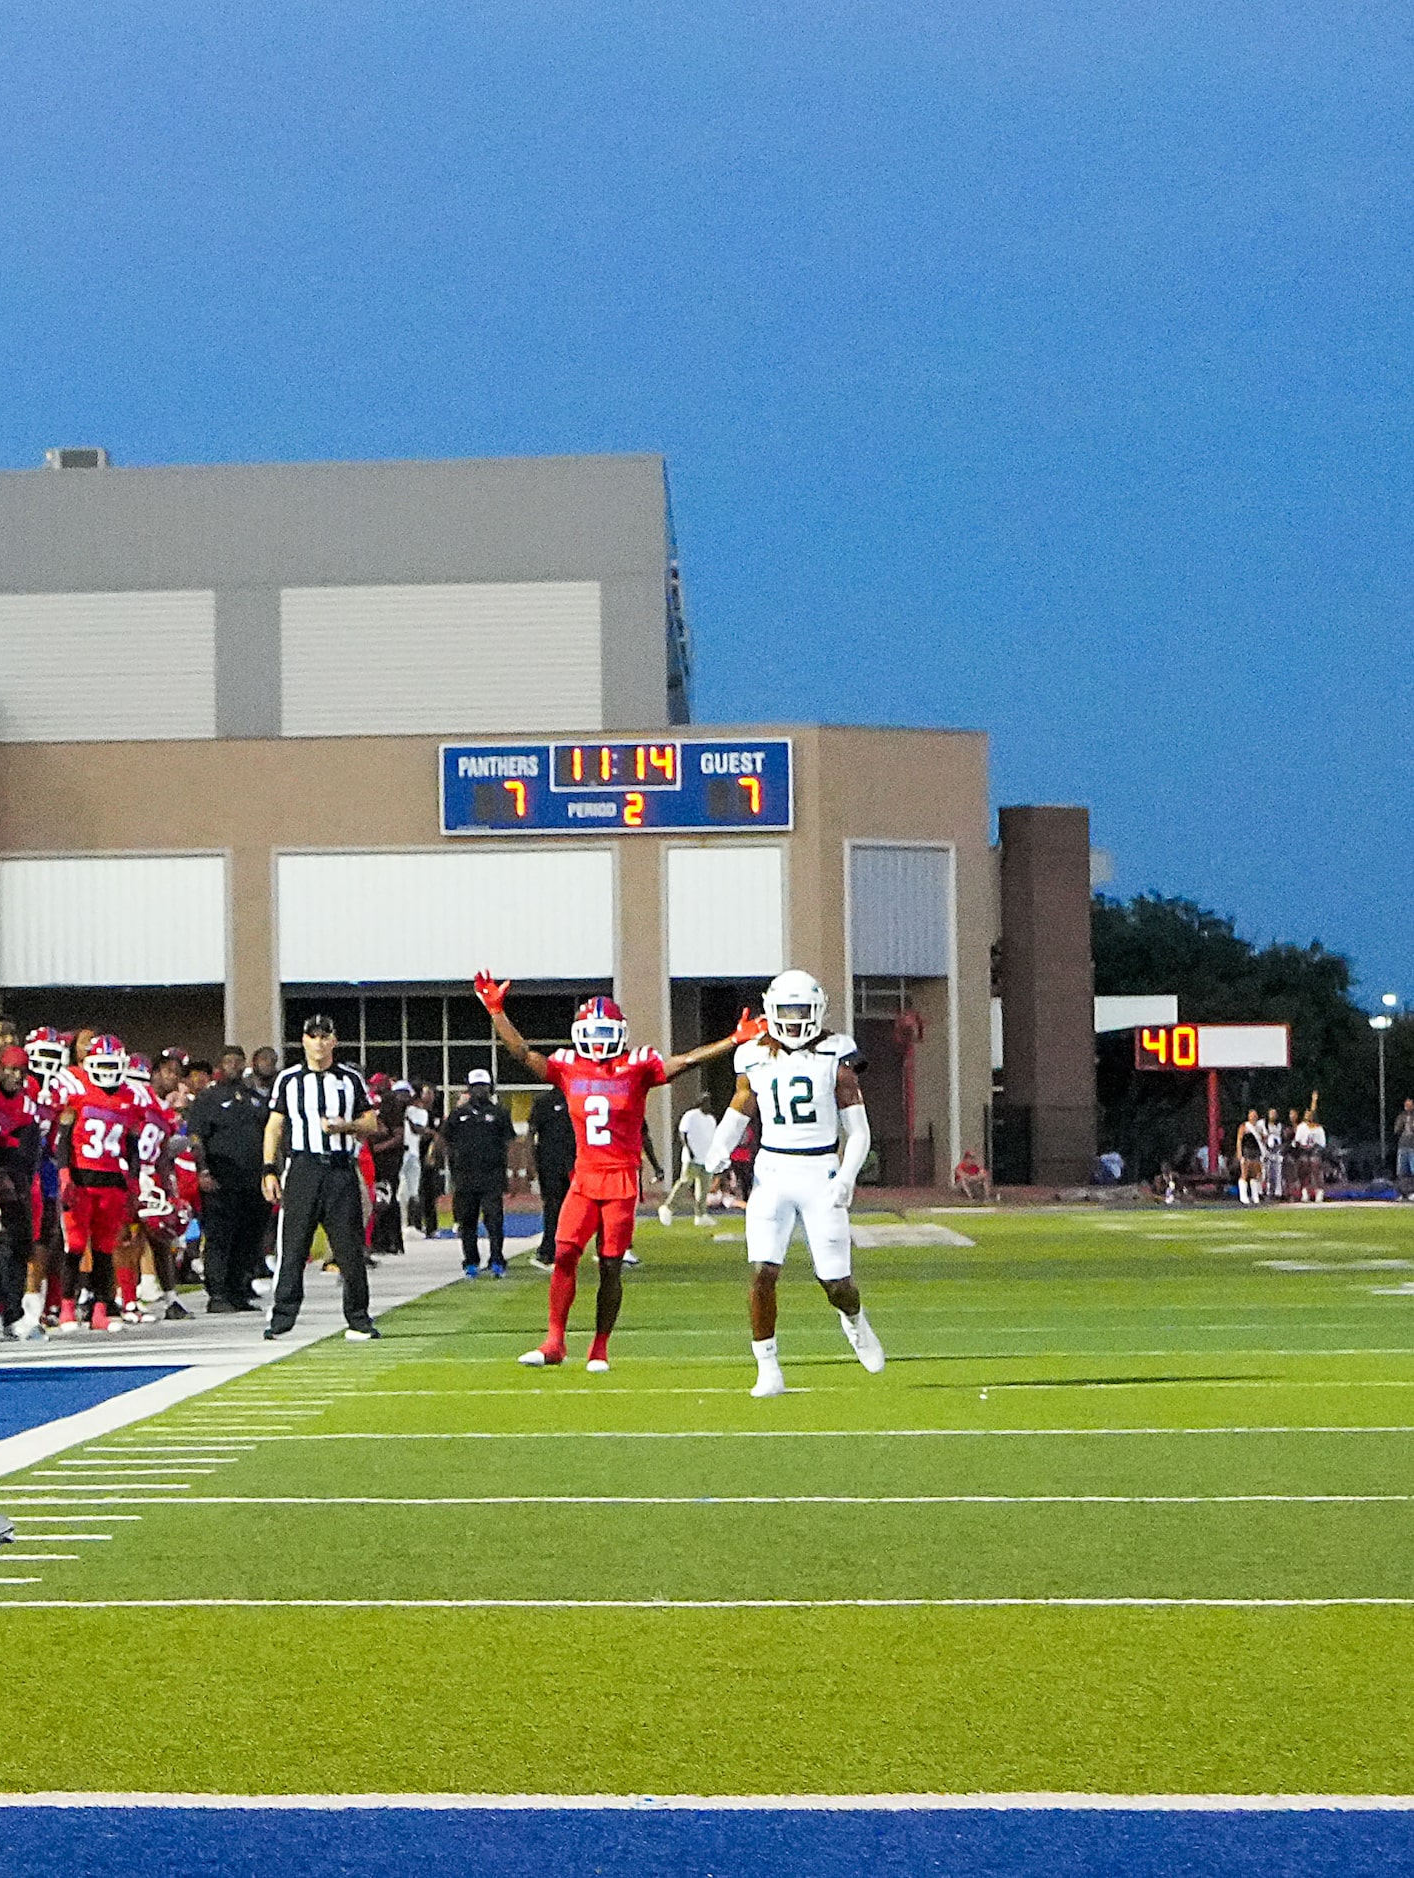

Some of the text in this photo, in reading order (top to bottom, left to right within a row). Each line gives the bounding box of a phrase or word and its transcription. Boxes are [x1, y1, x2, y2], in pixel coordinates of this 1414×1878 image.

[458, 755, 539, 778] PANTHERS
[572, 746, 674, 782] 11:14
[700, 751, 766, 775] GUEST
[502, 778, 527, 818] 7
[567, 790, 645, 827] PERIOD 2
[737, 775, 762, 814] 7
[1141, 1027, 1196, 1067] 40
[770, 1076, 817, 1124] 12
[81, 1118, 124, 1159] 34
[583, 1095, 612, 1146] 2
